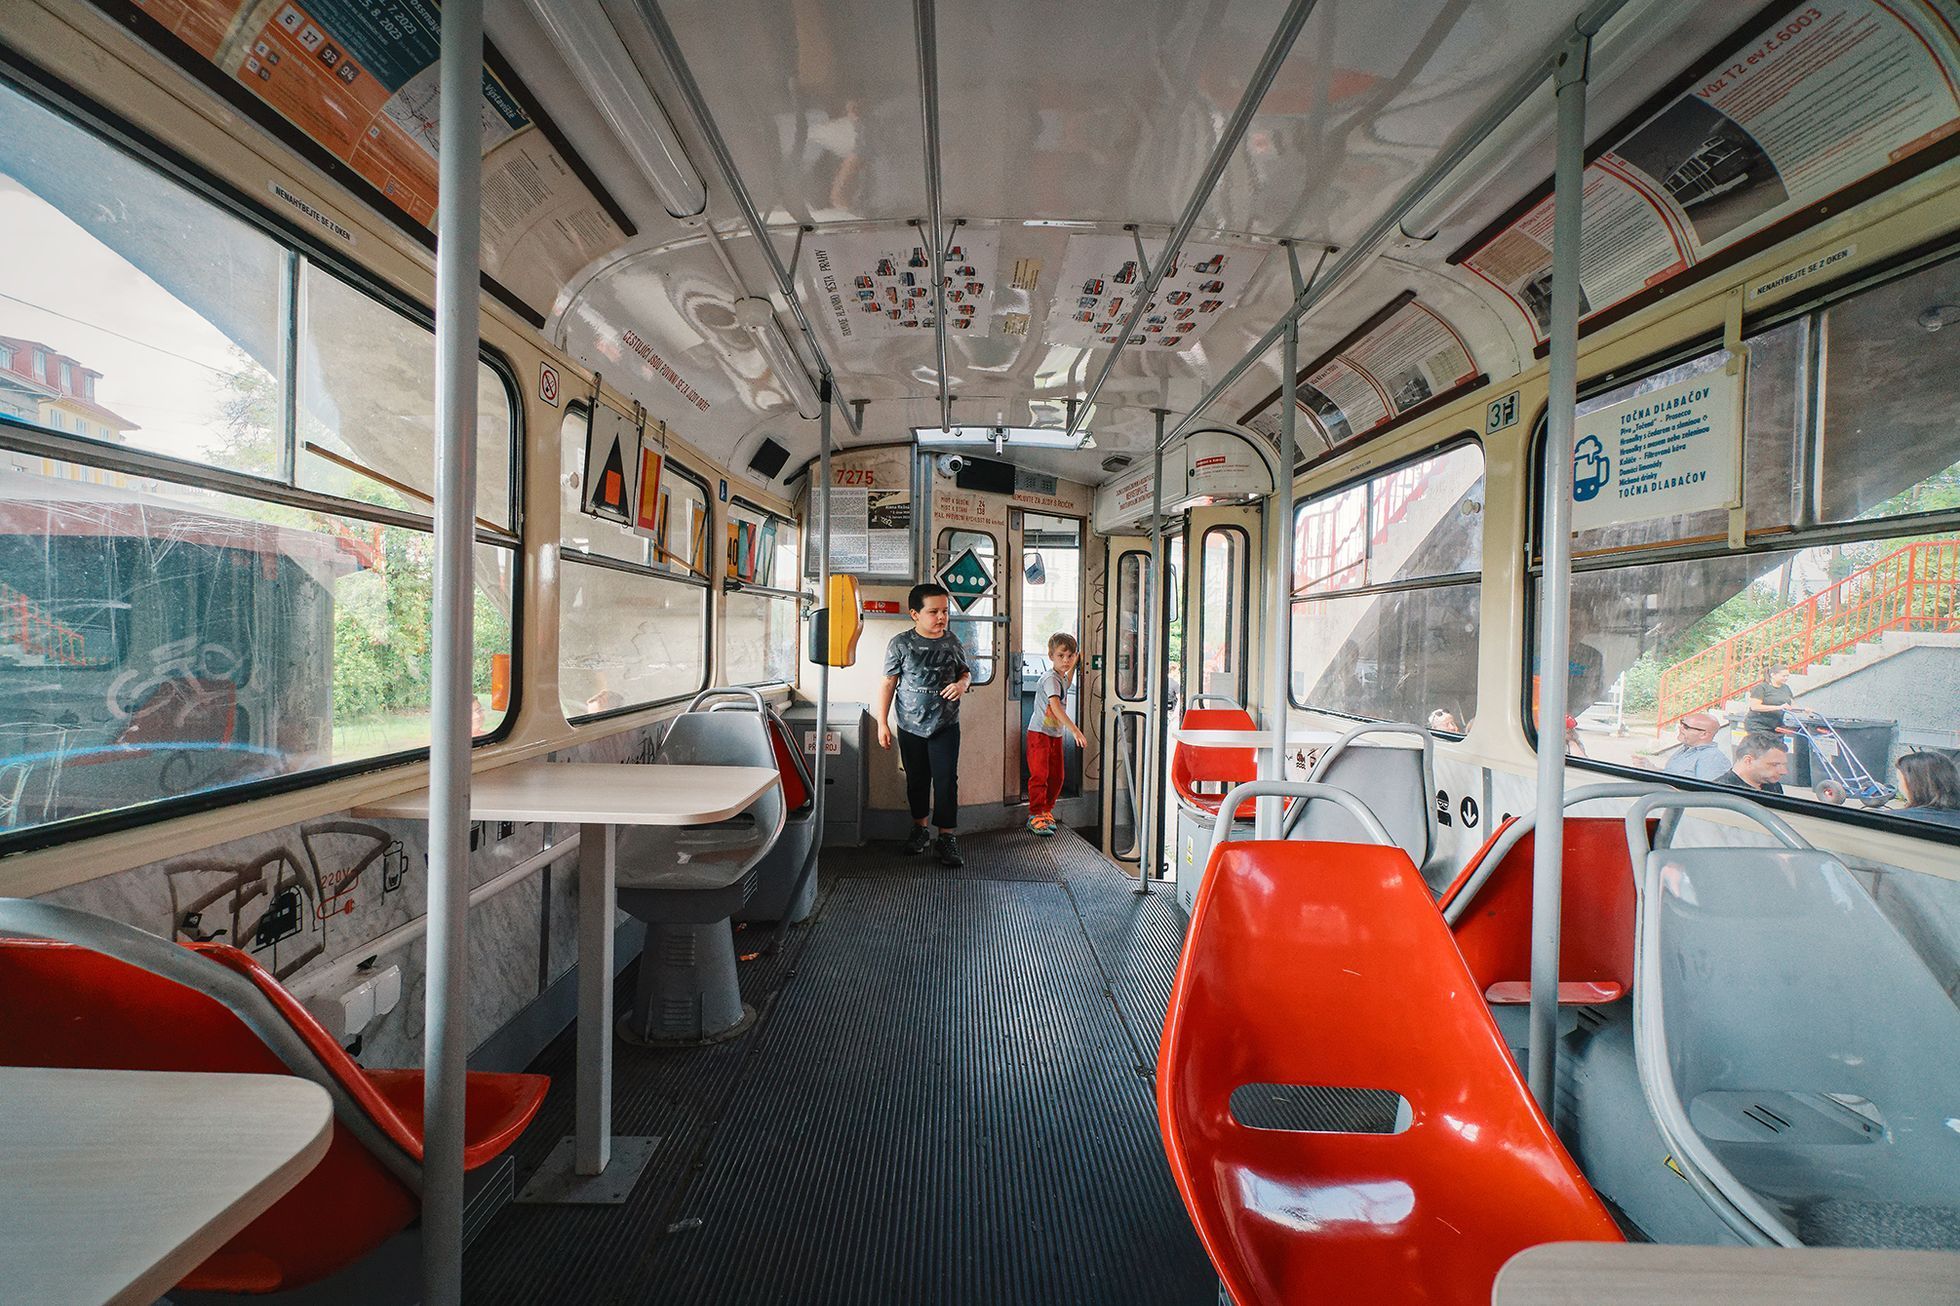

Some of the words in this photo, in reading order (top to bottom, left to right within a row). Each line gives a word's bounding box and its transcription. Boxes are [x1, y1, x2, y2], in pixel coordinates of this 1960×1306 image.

[379, 18, 402, 40] 2023
[394, 12, 417, 35] 2023
[303, 30, 318, 44] 17
[322, 49, 337, 64] 93
[341, 66, 354, 80] 94
[1722, 63, 1748, 80] T2
[321, 216, 329, 227] SE
[335, 225, 351, 240] OKEN
[815, 249, 831, 271] PRAHY
[1757, 267, 1806, 295] NENAHÝBEJTE
[1808, 263, 1818, 272] SE
[1826, 249, 1848, 264] OKEN
[622, 330, 654, 360] CESTUJÍCÍ
[648, 354, 664, 370] JSOU
[1490, 403, 1501, 427] 3
[1620, 408, 1651, 425] TOČNA
[1654, 387, 1710, 414] DLABAČOV
[1665, 409, 1692, 421] Prosecco
[1620, 434, 1643, 445] Hranolky
[1676, 418, 1701, 429] slaninou
[1620, 445, 1642, 456] Hranolky
[1667, 433, 1681, 442] nebo
[1682, 426, 1710, 439] zeleninou
[837, 470, 874, 485] 7275
[1619, 484, 1648, 498] TOČNA
[1651, 471, 1706, 492] DLABAČOV
[1641, 472, 1658, 482] drinky
[320, 867, 350, 889] 220V
